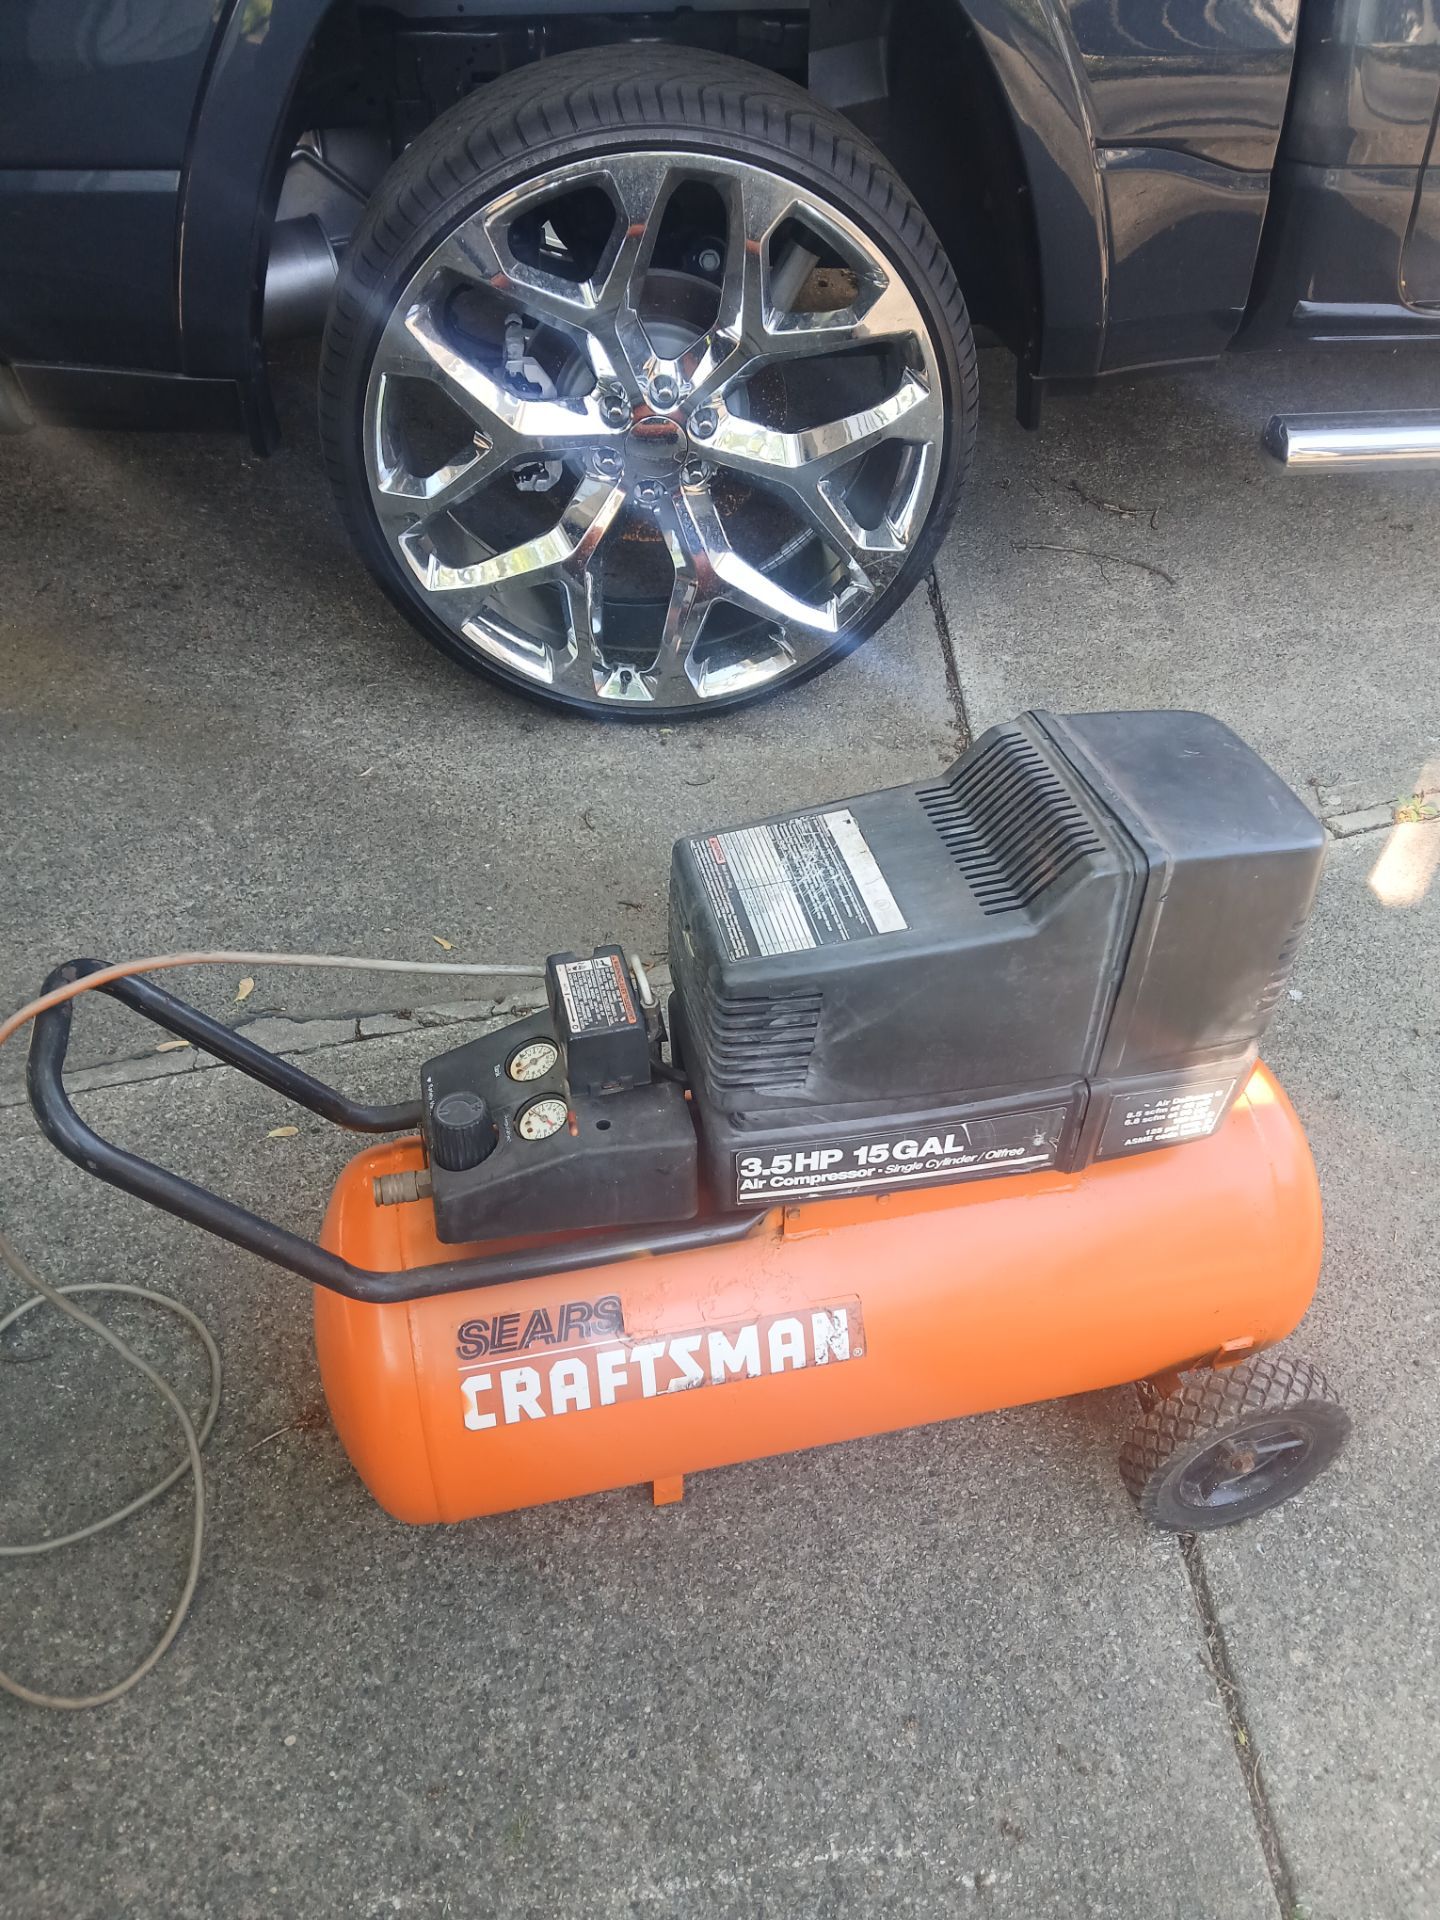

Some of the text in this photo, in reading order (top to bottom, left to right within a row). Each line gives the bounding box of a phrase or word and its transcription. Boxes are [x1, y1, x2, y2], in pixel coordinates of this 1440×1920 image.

[1124, 1136, 1154, 1146] ASME
[740, 1179, 766, 1190] Air
[770, 1167, 876, 1187] Compressor
[885, 1162, 922, 1174] Single
[456, 1295, 625, 1361] SEARS
[461, 1308, 851, 1431] CRAFTSMAN
